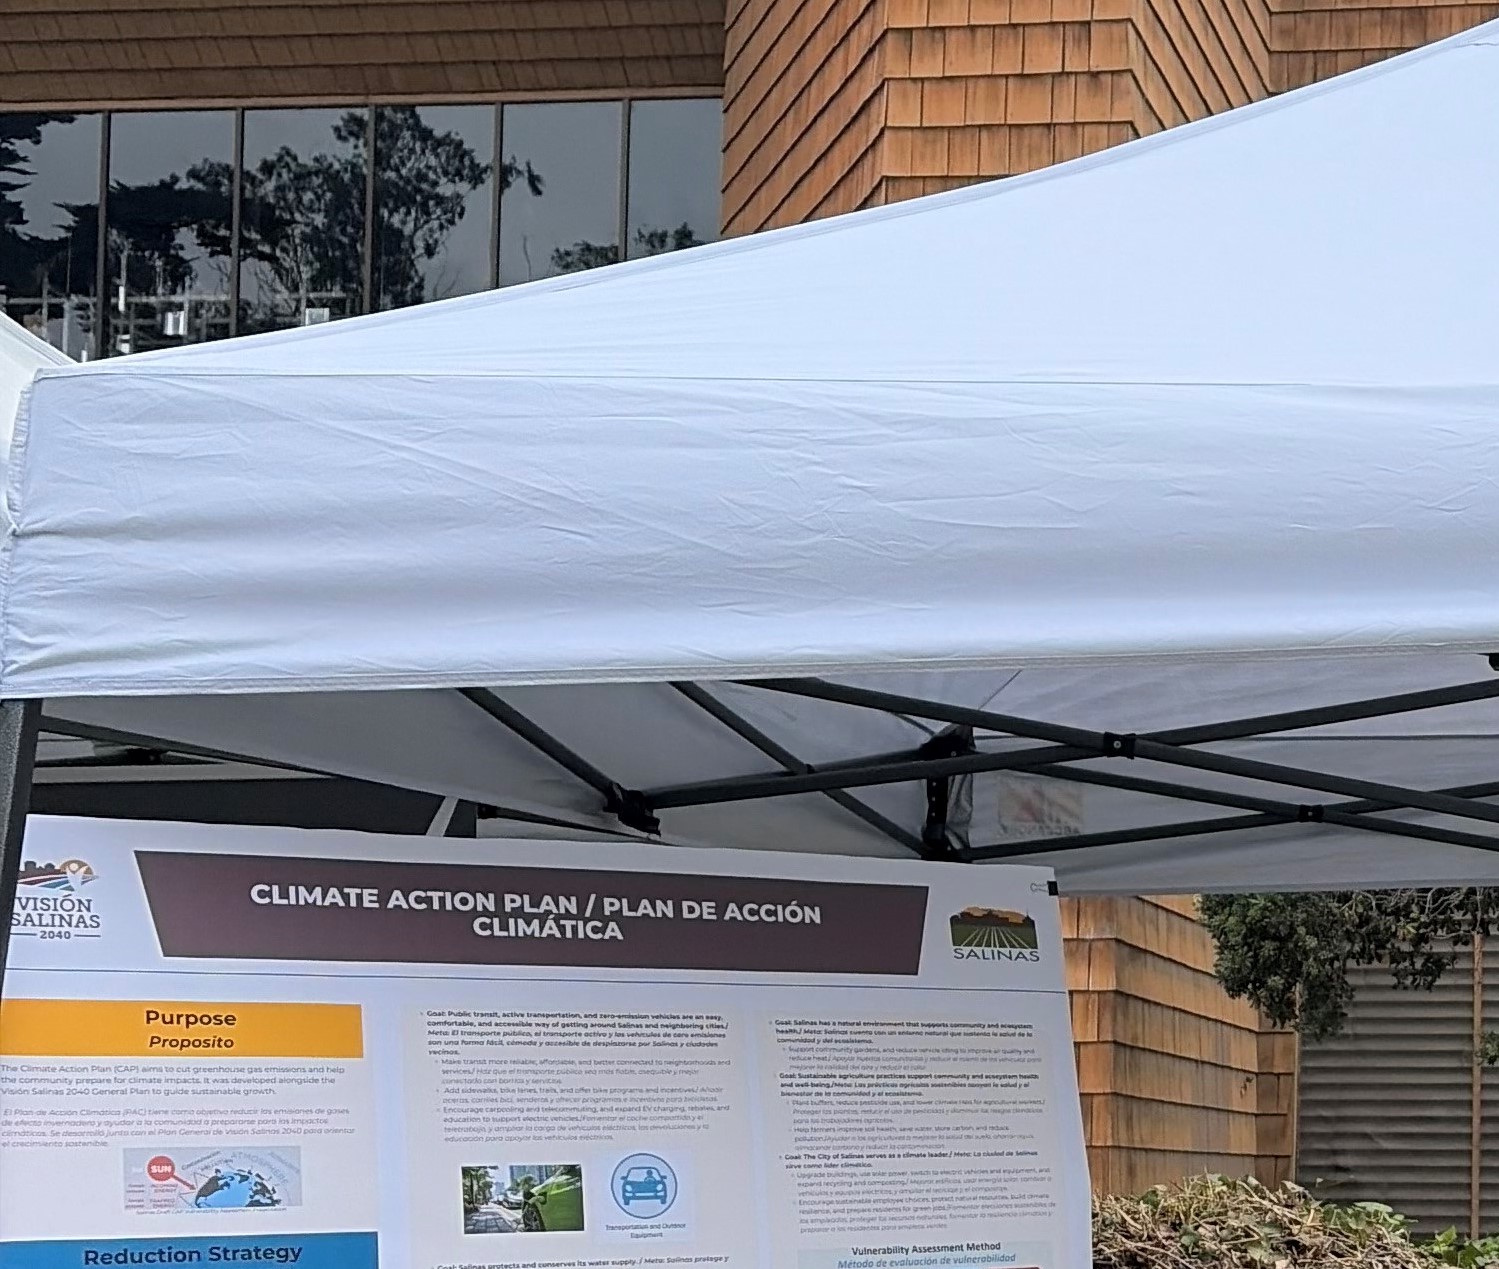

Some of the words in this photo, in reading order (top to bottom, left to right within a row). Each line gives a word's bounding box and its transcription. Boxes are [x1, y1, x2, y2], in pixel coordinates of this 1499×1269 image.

[15, 894, 92, 912] VISIÓN
[250, 884, 379, 908] CLIMATE
[387, 889, 495, 911] ACTION
[504, 894, 577, 915] PLAN
[584, 893, 596, 917] /
[603, 897, 674, 918] PLAN
[682, 901, 717, 920] DE
[724, 900, 821, 924] ACCIÓN
[11, 913, 100, 928] SALINAS
[473, 914, 624, 940] CLIMÁTICA
[40, 930, 71, 940] 2040
[953, 948, 1040, 962] SALINAS
[146, 1010, 237, 1029] Purpose
[149, 1035, 234, 1051] Proposito
[0, 1065, 18, 1073] The
[19, 1065, 57, 1073] Climate
[58, 1065, 89, 1073] Action
[90, 1065, 112, 1073] Plan
[113, 1065, 139, 1075] (CAP)
[141, 1065, 163, 1073] aims
[164, 1065, 174, 1073] to
[175, 1065, 191, 1073] cut
[192, 1065, 245, 1075] greenhouse
[246, 1067, 263, 1075] gas
[263, 1065, 306, 1073] emissions
[307, 1065, 325, 1073] and
[326, 1065, 345, 1075] help
[0, 1076, 17, 1084] the
[18, 1076, 73, 1086] community
[75, 1077, 112, 1086] prepare
[113, 1076, 125, 1084] for
[127, 1076, 162, 1084] climate
[203, 1076, 210, 1084] It
[230, 1076, 276, 1086] developed
[278, 1076, 319, 1086] alongside
[320, 1076, 335, 1084] the
[0, 1087, 30, 1095] Visión
[31, 1087, 64, 1095] Salinas
[66, 1087, 90, 1095] 2040
[91, 1087, 127, 1095] General
[129, 1087, 150, 1095] Plan
[151, 1087, 162, 1095] to
[163, 1087, 189, 1097] guide
[190, 1087, 241, 1095] sustainable
[242, 1087, 277, 1097] growth.
[150, 1165, 172, 1173] SUN
[84, 1246, 200, 1265] Reduction
[208, 1245, 303, 1263] Strategy
[852, 1245, 909, 1256] Vulnerability
[912, 1243, 964, 1254] Assessment
[966, 1242, 1001, 1251] Method
[837, 1258, 874, 1269] Método
[876, 1258, 888, 1268] de
[889, 1256, 938, 1267] evaluación
[940, 1256, 951, 1265] de
[953, 1254, 1016, 1264] vulnerabilidad
